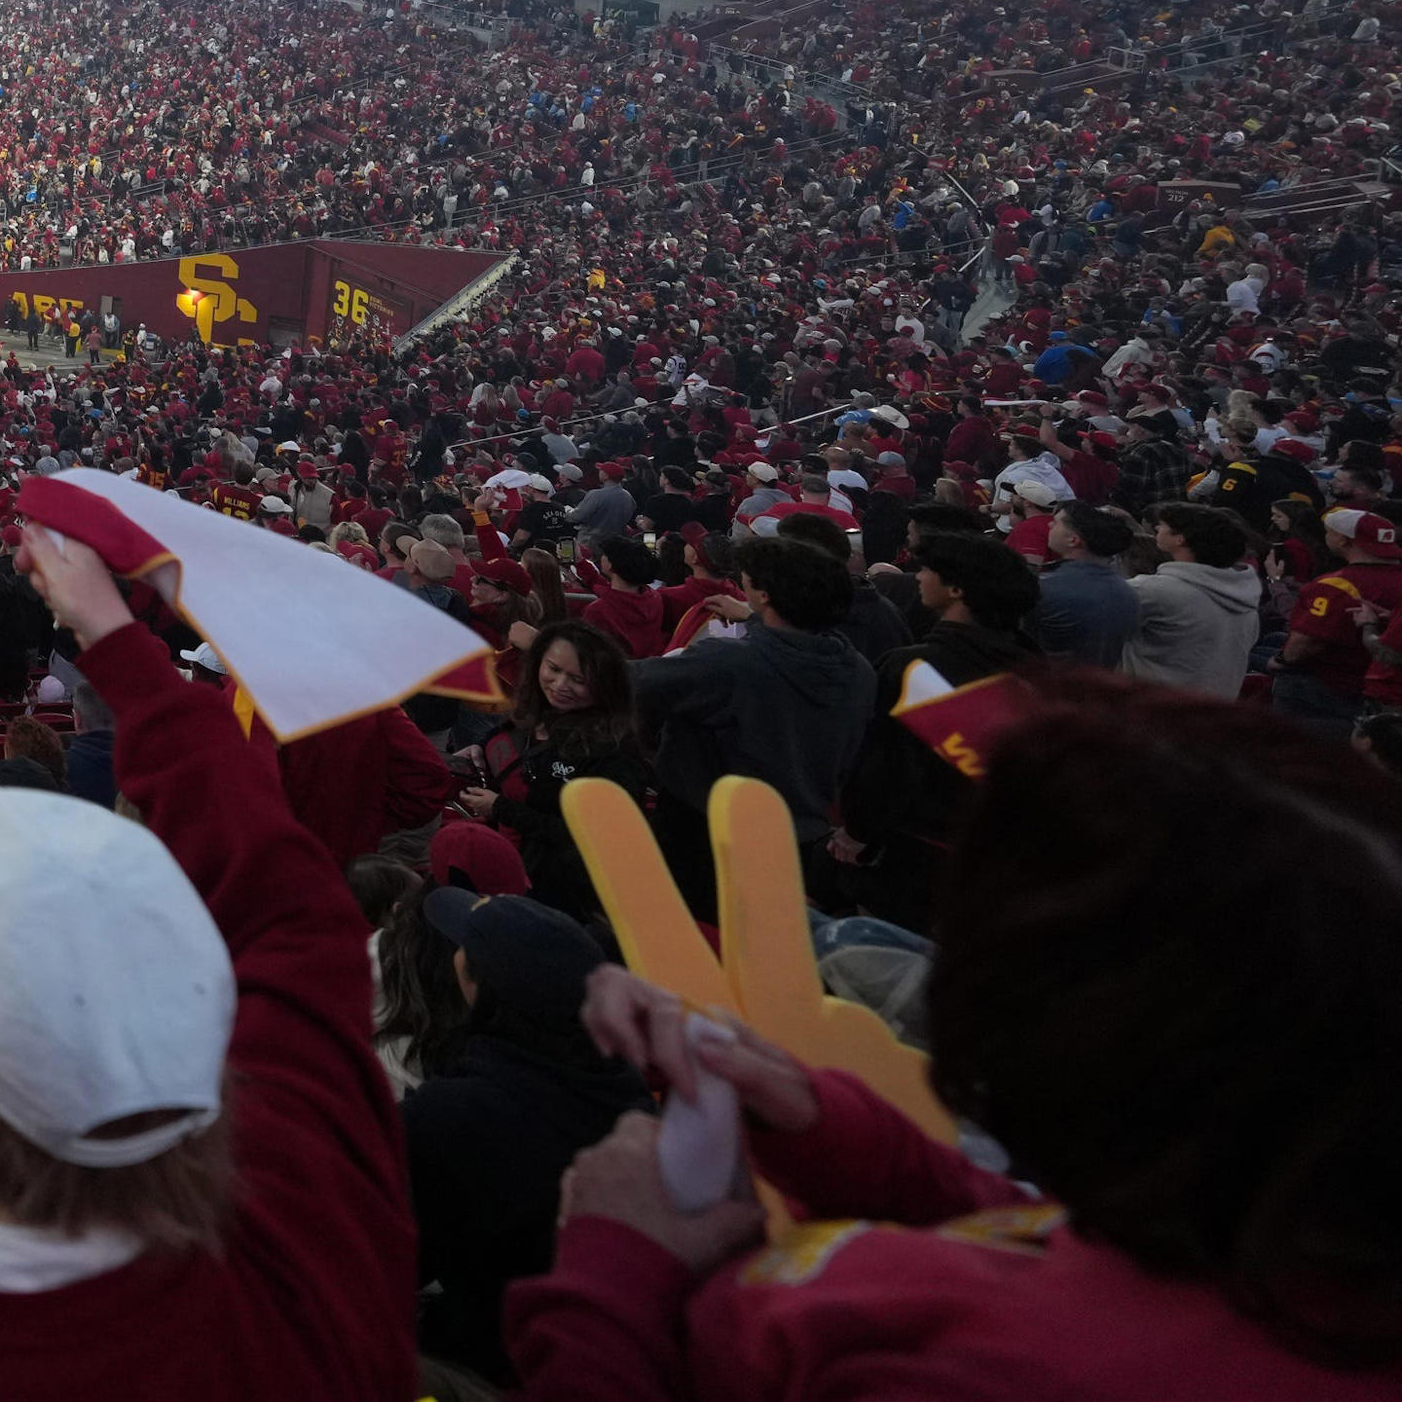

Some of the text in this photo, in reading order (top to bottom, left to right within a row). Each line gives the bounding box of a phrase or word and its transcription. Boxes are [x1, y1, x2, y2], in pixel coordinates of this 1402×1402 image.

[1167, 194, 1185, 202] 212
[333, 280, 369, 325] 36
[1222, 478, 1239, 491] 6
[223, 496, 251, 510] WILLIAMS
[1309, 596, 1329, 617] 9
